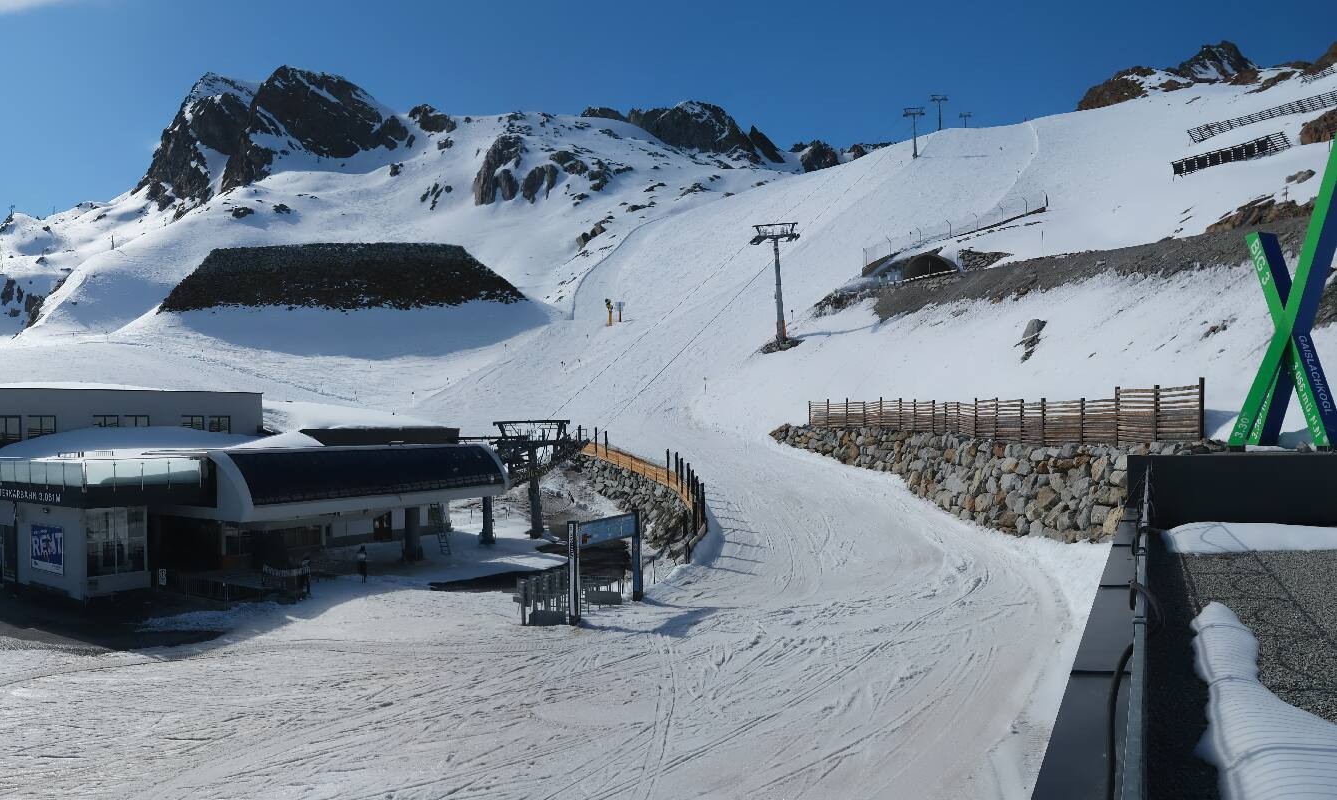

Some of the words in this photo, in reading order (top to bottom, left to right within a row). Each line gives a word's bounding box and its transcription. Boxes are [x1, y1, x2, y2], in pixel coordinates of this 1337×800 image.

[1250, 238, 1266, 272] BIG
[1261, 271, 1270, 286] 3
[1298, 335, 1332, 415] GAISLACHKOGL
[31, 532, 62, 556] RENT
